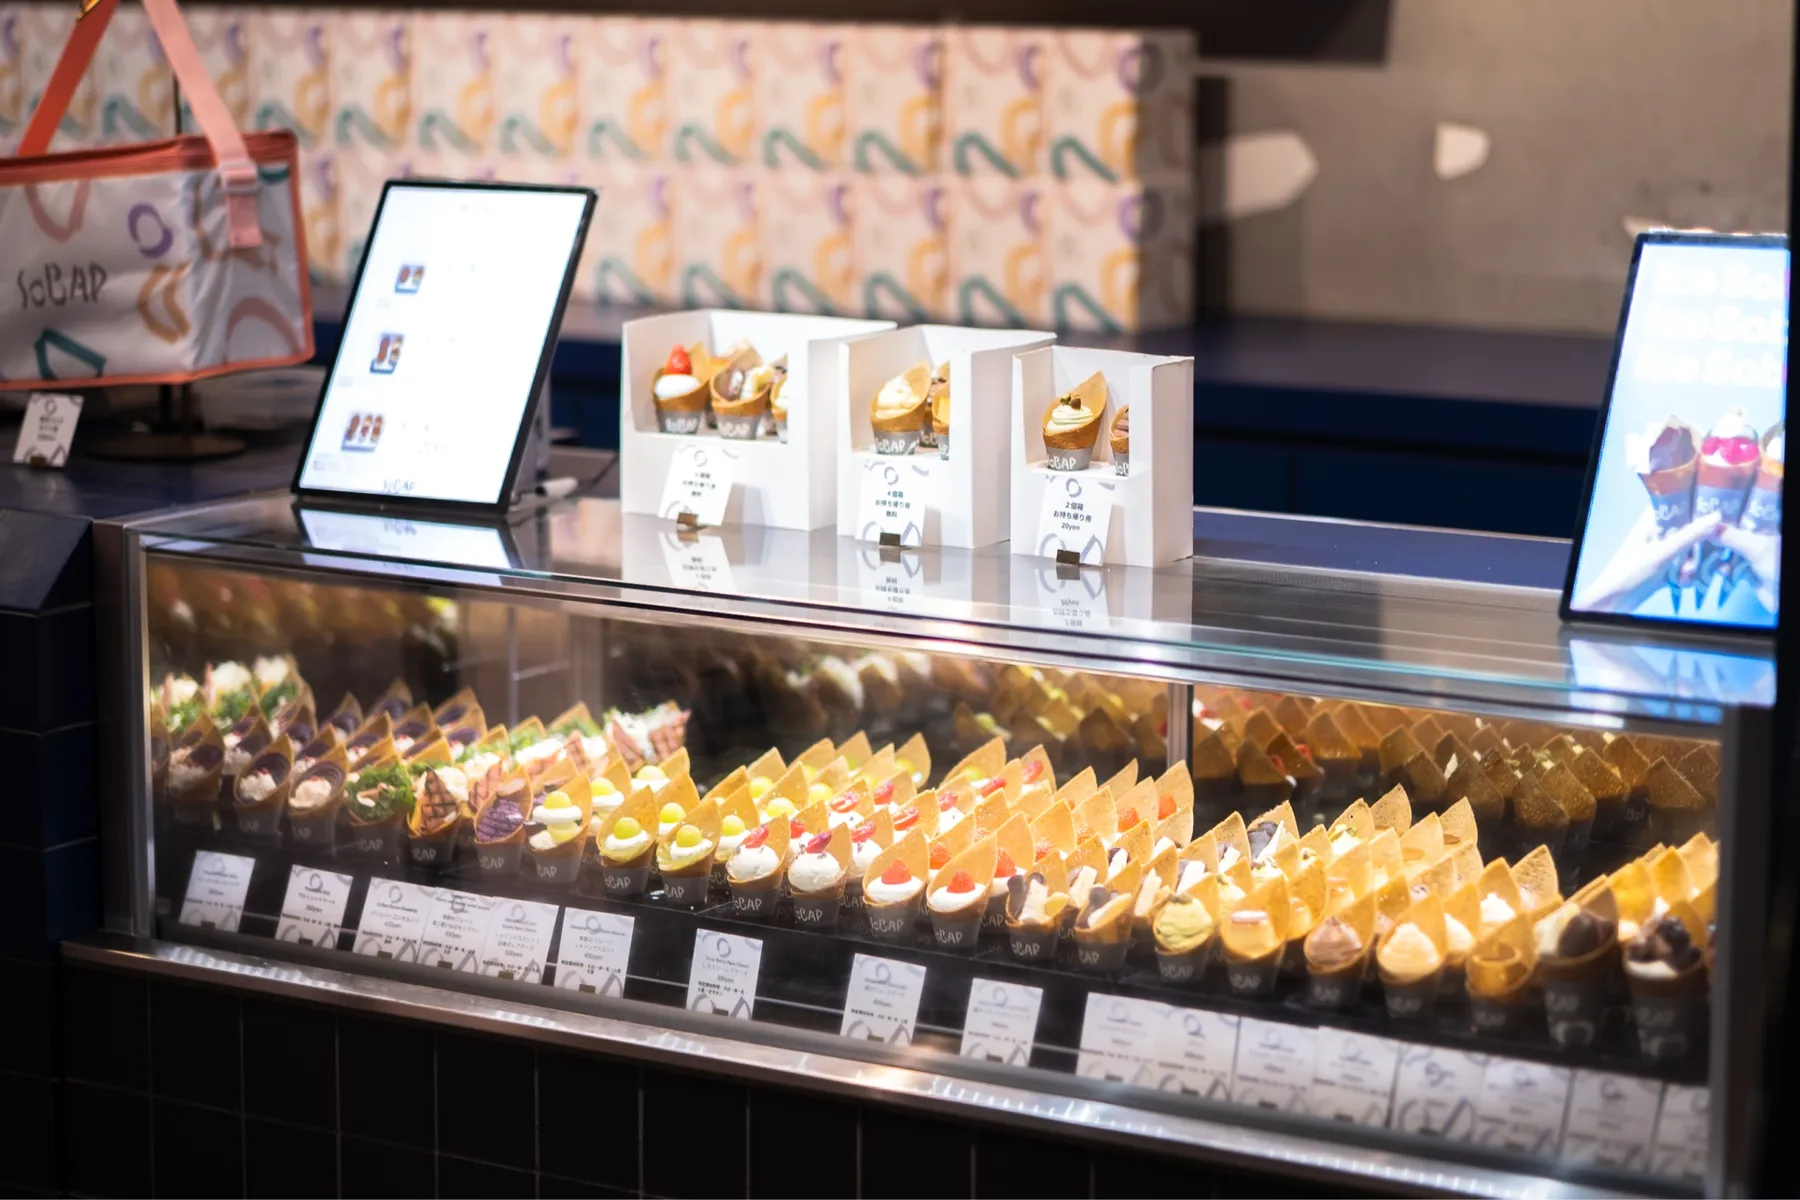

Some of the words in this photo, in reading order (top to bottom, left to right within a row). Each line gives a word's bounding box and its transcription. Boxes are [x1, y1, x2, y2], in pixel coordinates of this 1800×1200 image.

[1048, 455, 1077, 470] oBAP
[1053, 510, 1092, 523] お持ち帰り用
[1061, 522, 1080, 531] 20yen
